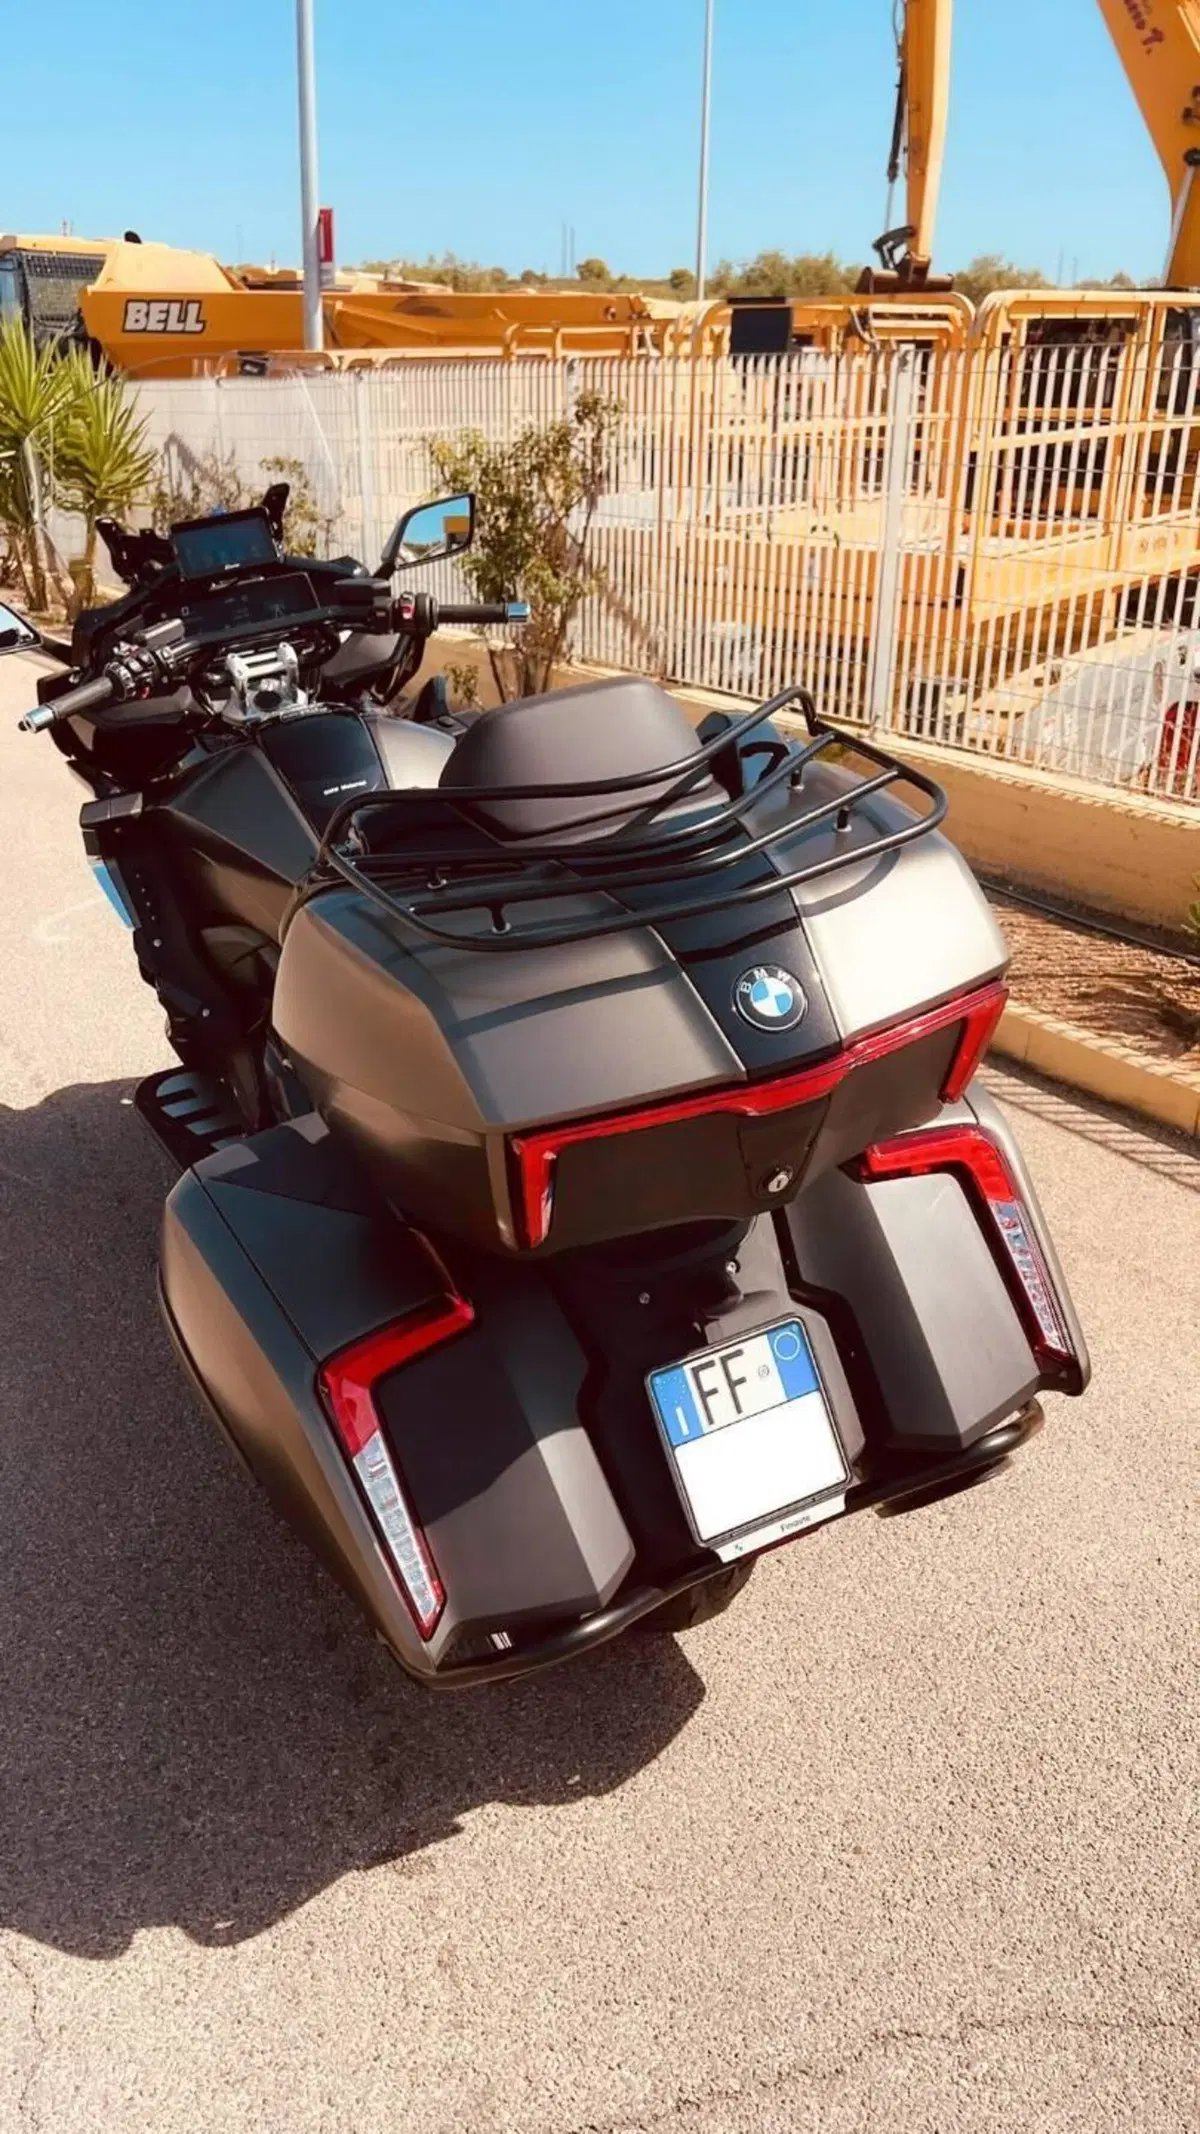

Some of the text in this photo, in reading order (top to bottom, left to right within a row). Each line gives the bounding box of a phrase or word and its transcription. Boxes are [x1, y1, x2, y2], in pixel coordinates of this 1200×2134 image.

[122, 300, 206, 333] BELL
[740, 968, 791, 993] BMW
[690, 1348, 748, 1426] FF
